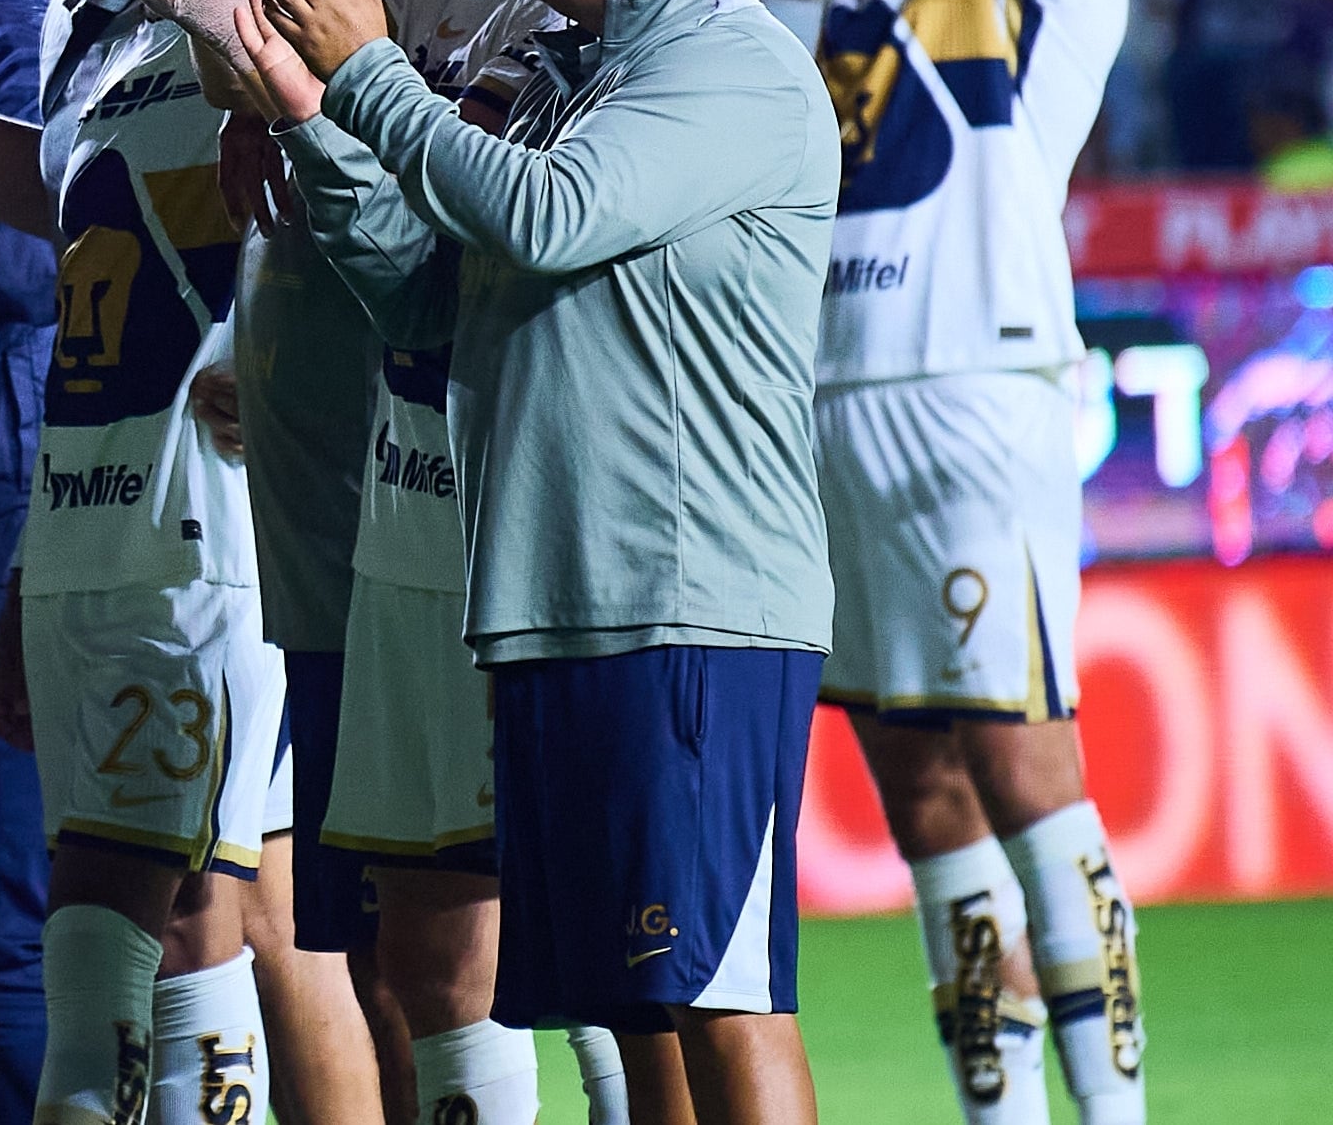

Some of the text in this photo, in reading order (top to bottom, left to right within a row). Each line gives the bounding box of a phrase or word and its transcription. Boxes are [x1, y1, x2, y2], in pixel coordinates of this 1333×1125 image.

[400, 448, 459, 499] Mife
[942, 567, 989, 648] 9
[96, 683, 212, 782] 23
